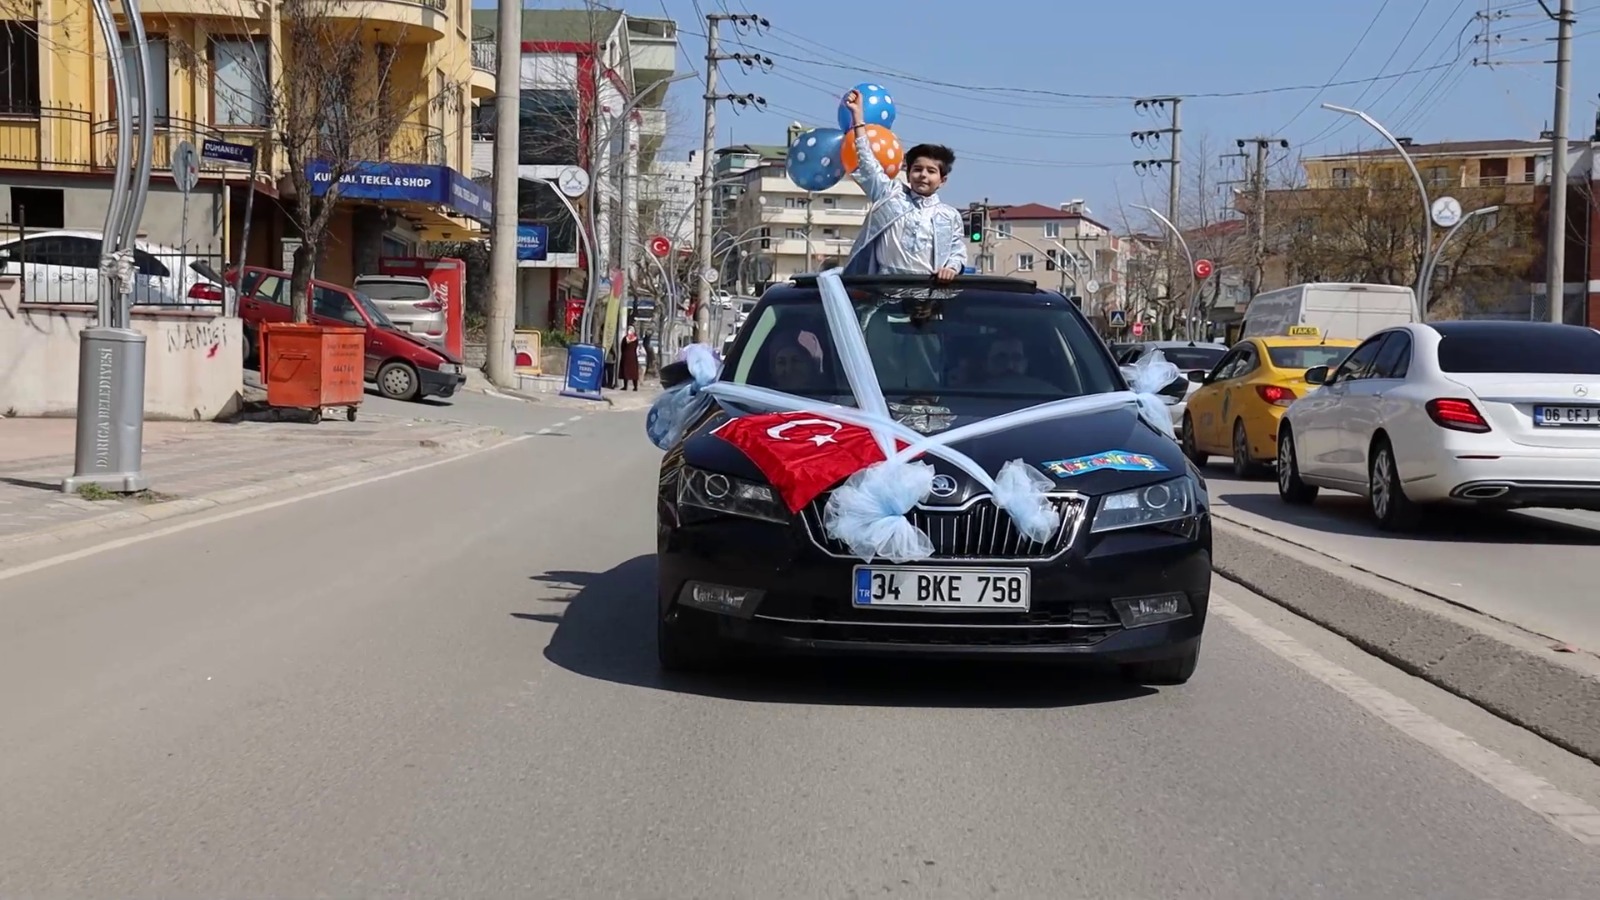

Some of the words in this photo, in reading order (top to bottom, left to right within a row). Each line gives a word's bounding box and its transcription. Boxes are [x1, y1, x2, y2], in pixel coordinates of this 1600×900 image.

[314, 172, 357, 183] KUSAL
[360, 175, 393, 186] TEKEL
[394, 178, 401, 186] &
[402, 178, 431, 187] SHOP
[98, 348, 113, 419] BELEDİYESİ
[1545, 408, 1560, 421] 06
[1567, 409, 1590, 422] CFJ
[859, 589, 870, 597] TR
[872, 574, 900, 600] 34
[917, 575, 962, 602] BKE
[977, 576, 1021, 603] 758
